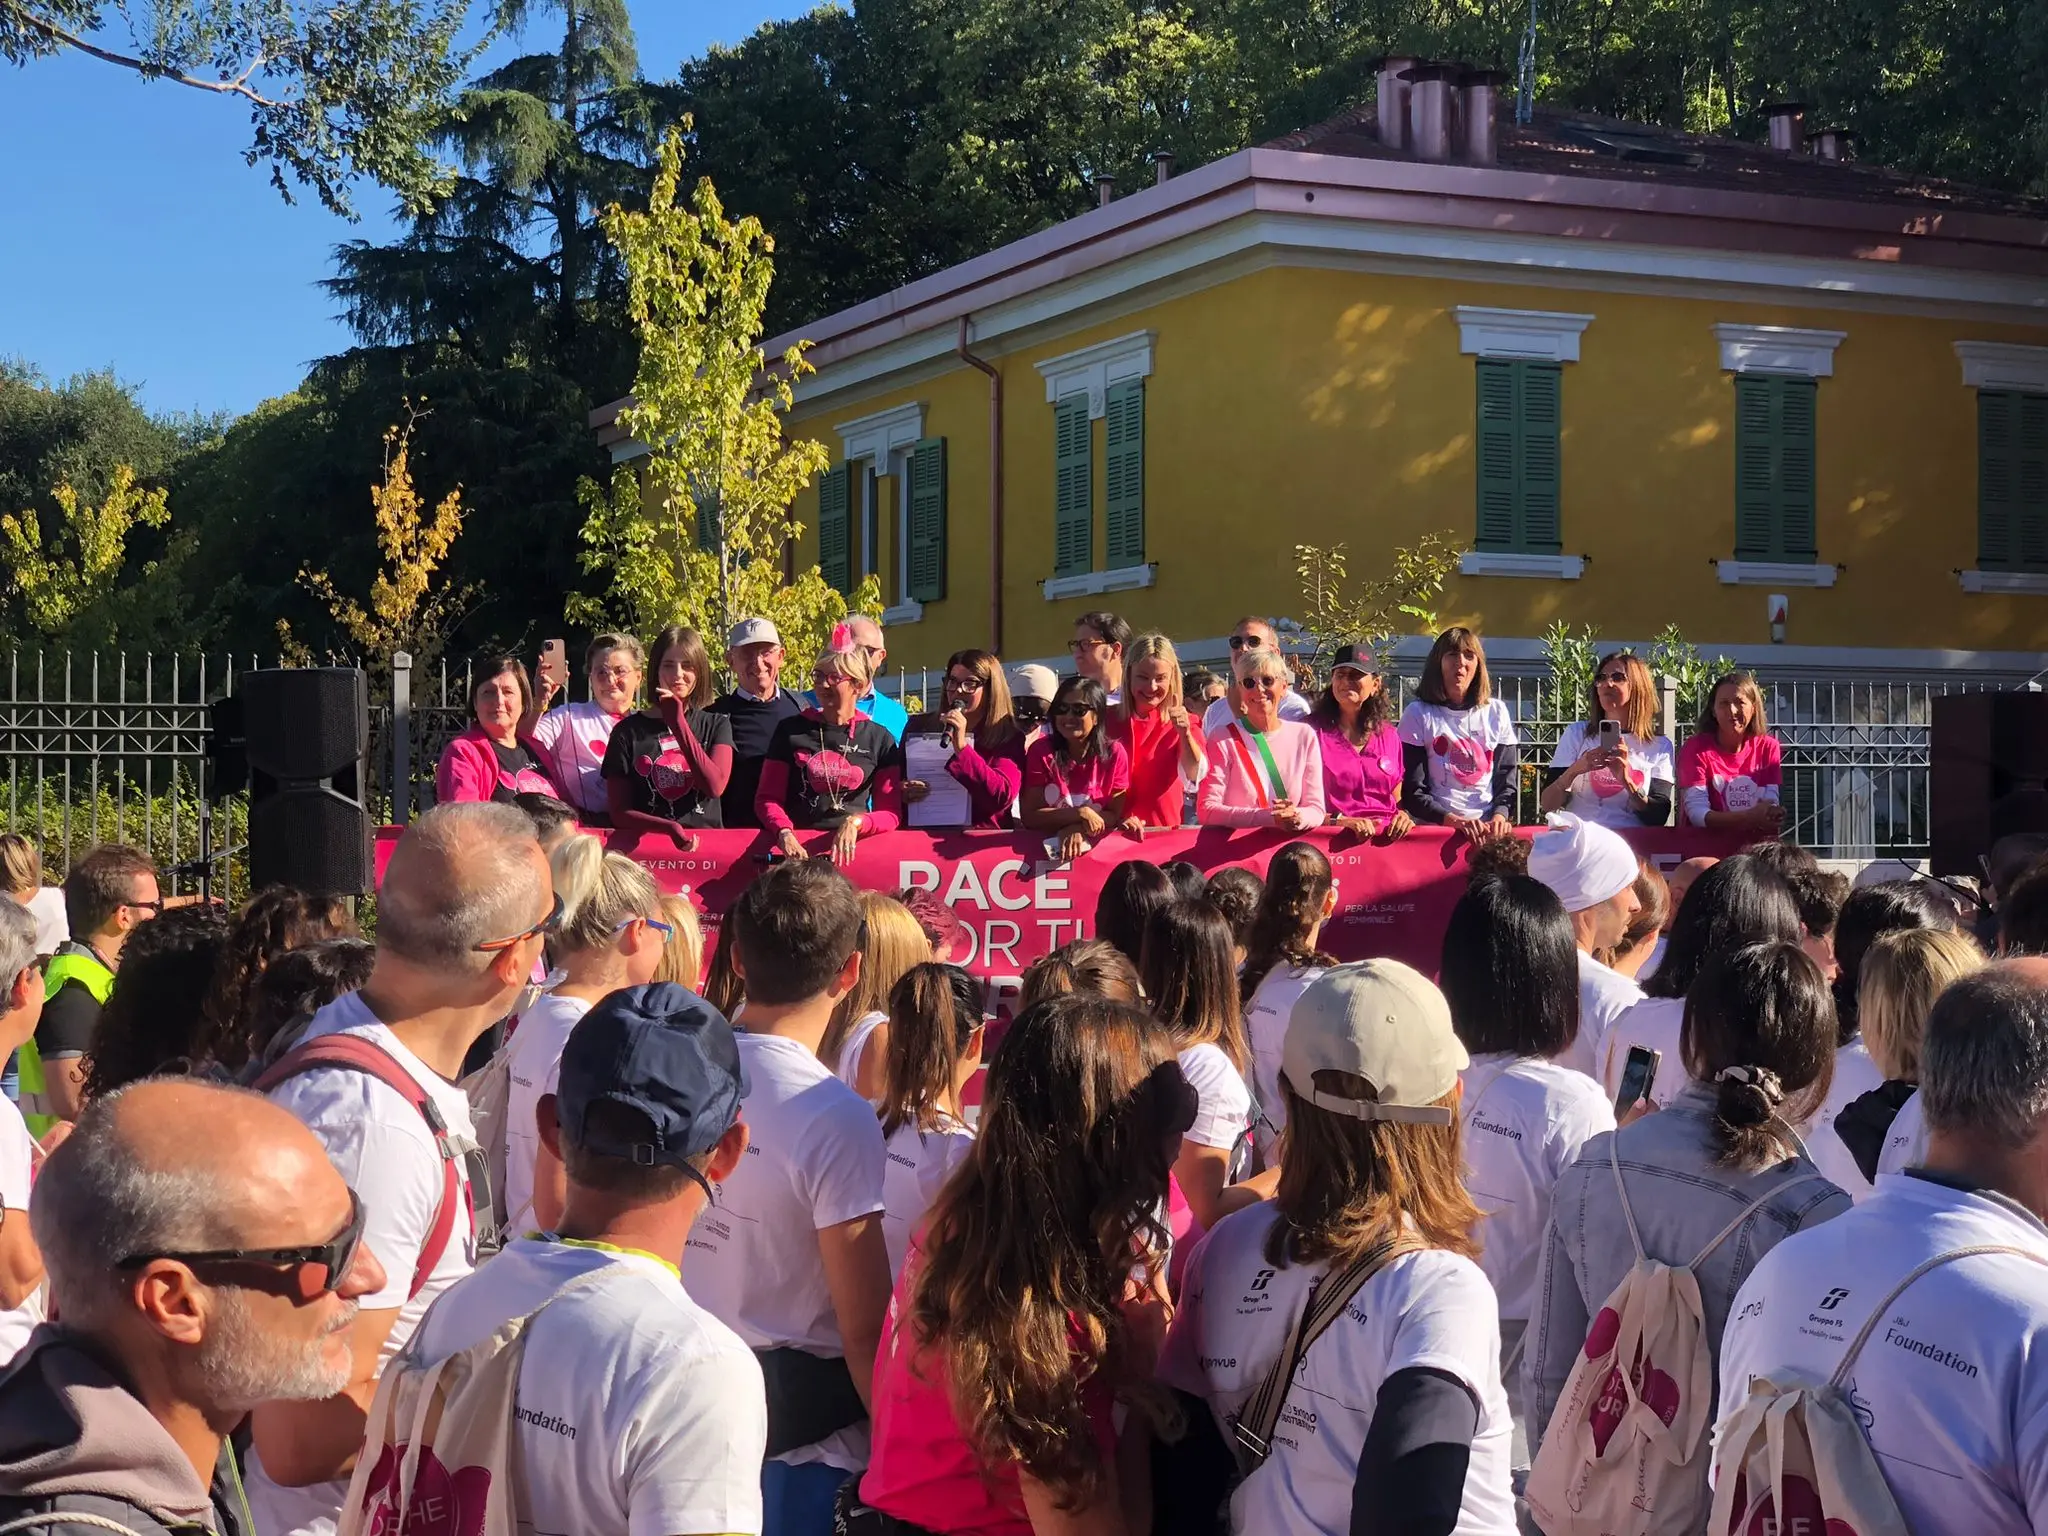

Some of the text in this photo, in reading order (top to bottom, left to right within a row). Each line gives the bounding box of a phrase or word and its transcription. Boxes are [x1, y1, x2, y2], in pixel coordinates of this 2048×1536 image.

[640, 859, 717, 870] EVENTO DI
[1349, 856, 1361, 865] DI
[1344, 904, 1363, 913] PER
[950, 919, 1021, 968] OR
[1471, 1117, 1522, 1141] Foundation
[1808, 1313, 1834, 1326] Gruppo
[1884, 1328, 1979, 1379] Foundation
[517, 1406, 577, 1440] undation
